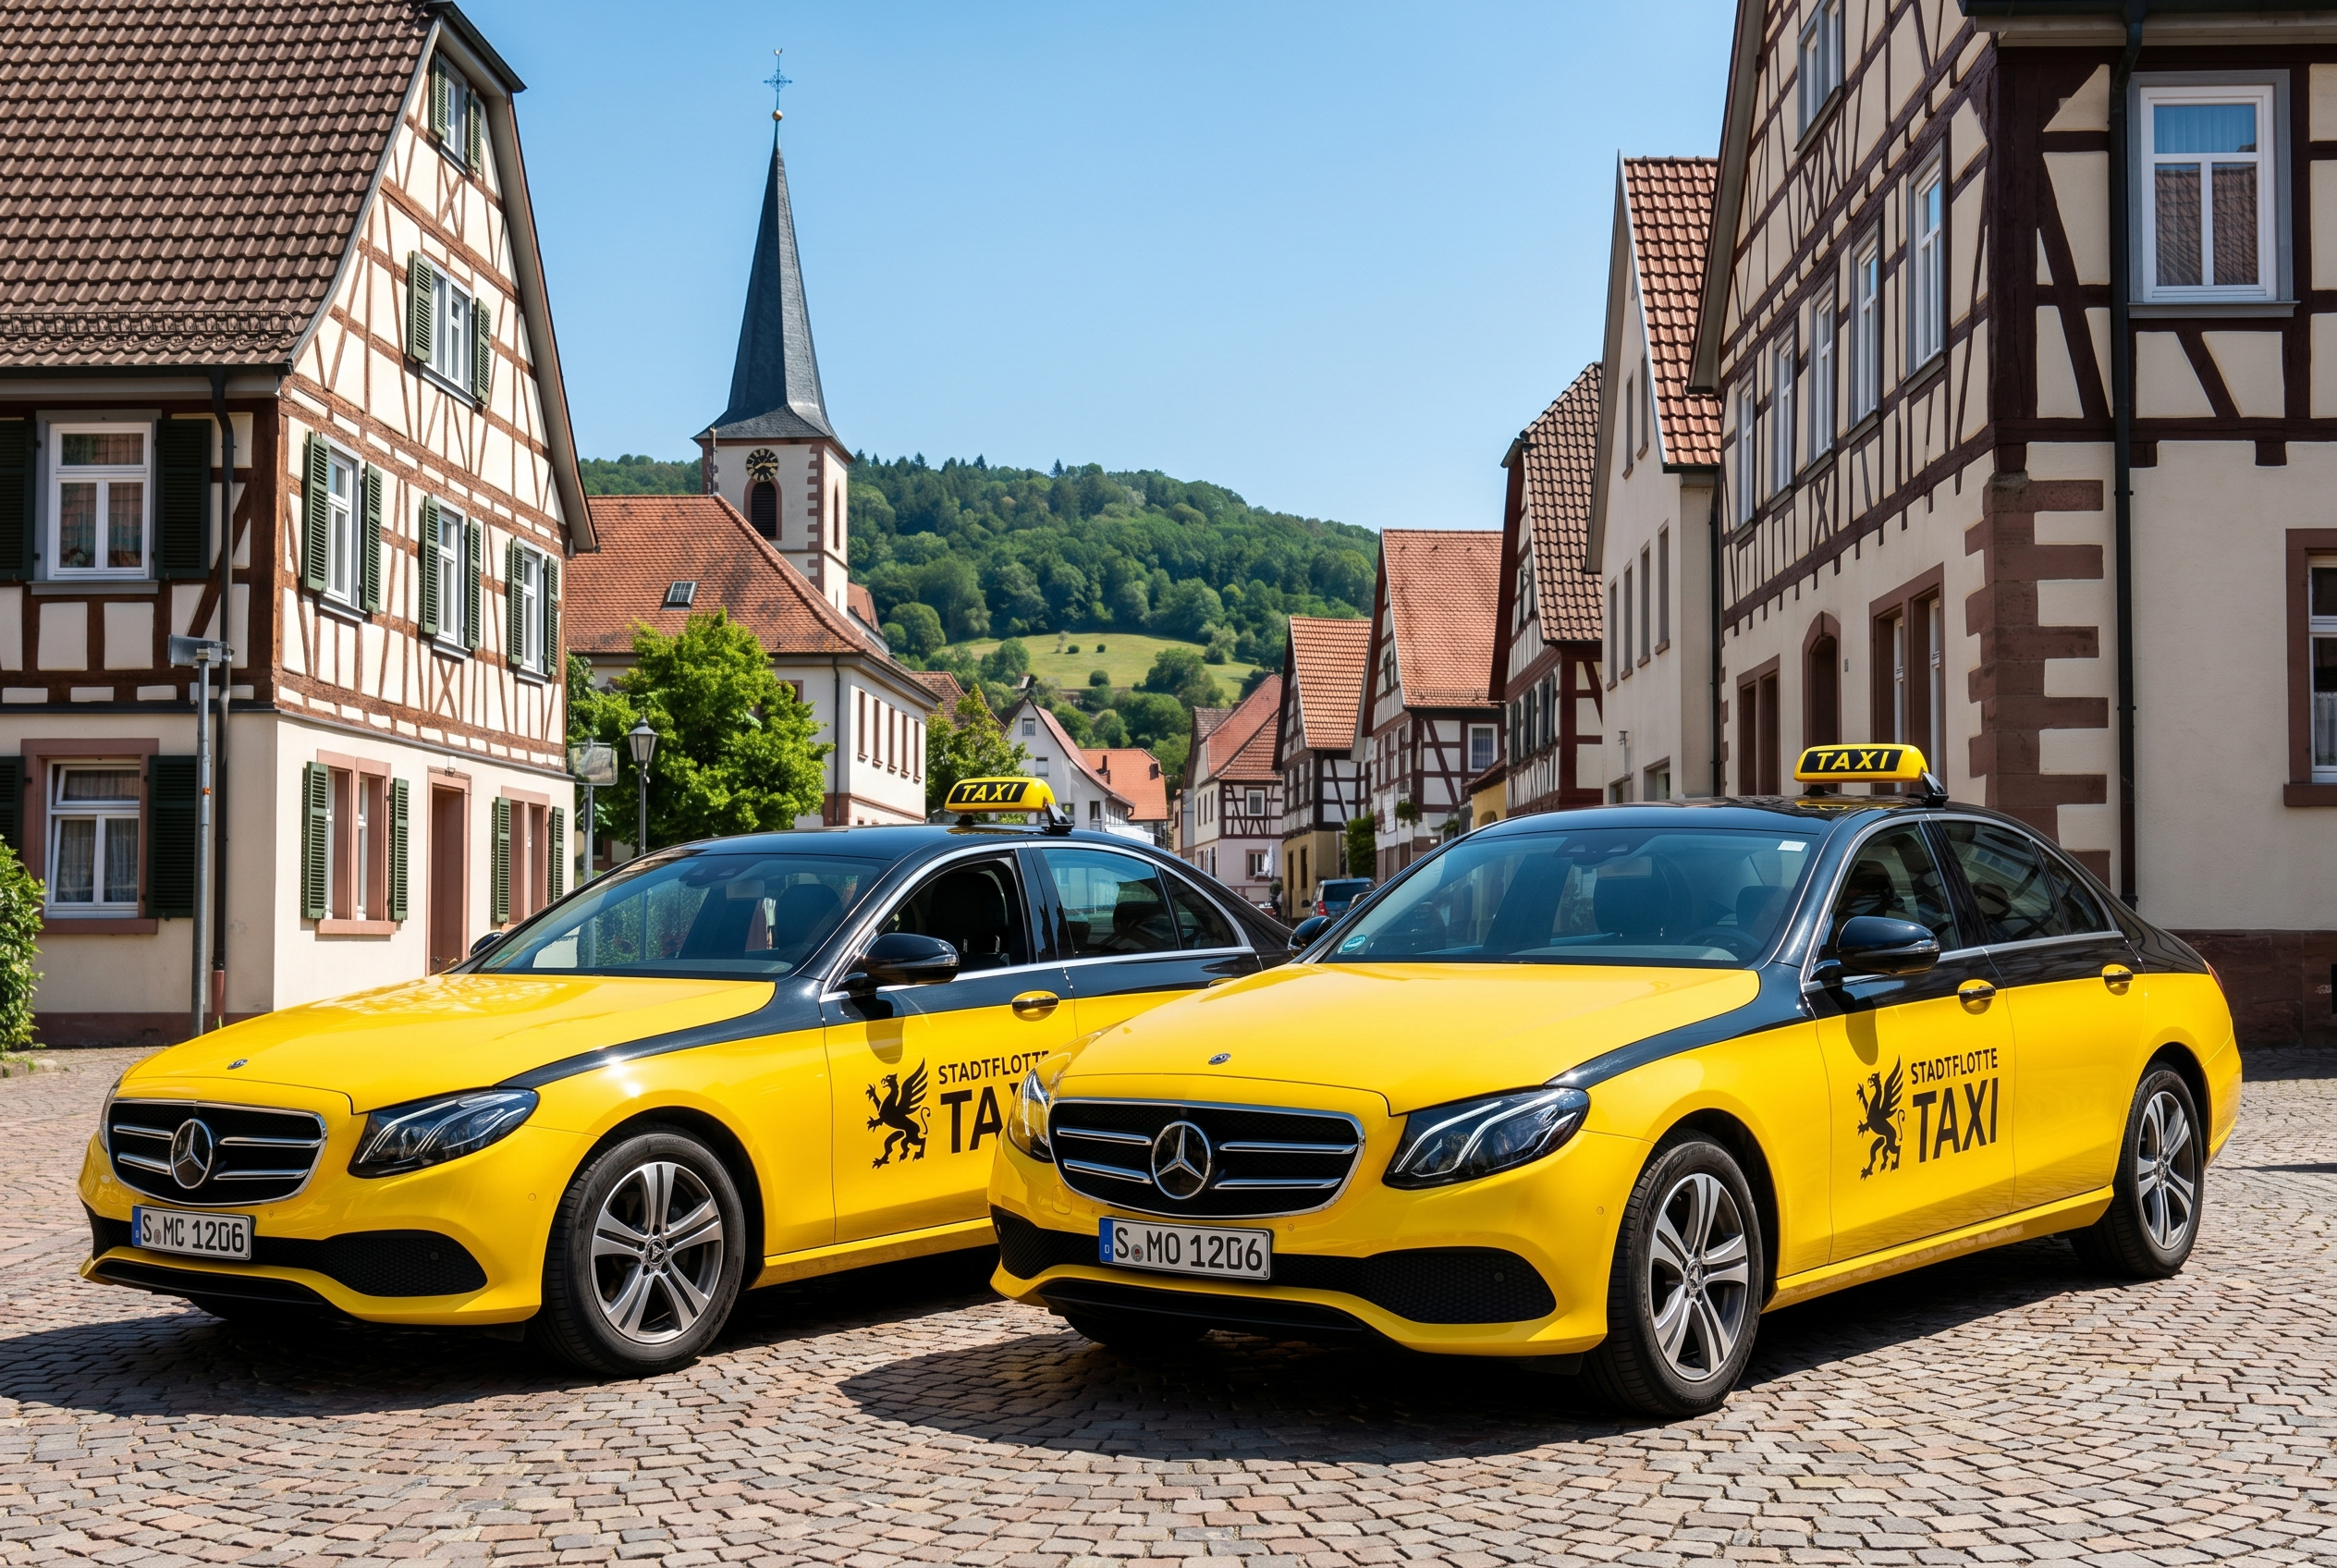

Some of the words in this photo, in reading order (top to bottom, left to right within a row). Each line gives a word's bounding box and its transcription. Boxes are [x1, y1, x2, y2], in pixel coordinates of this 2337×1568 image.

[1817, 751, 1890, 771] TAXI
[960, 783, 1019, 802] TAXI
[938, 1050, 1049, 1085] STADTFLOTT
[1910, 1047, 1999, 1085] STADTFLOTTE
[940, 1082, 1020, 1155] TA
[1912, 1077, 1999, 1164] TAXI
[142, 1214, 152, 1243] S
[163, 1216, 185, 1247] MC
[191, 1219, 245, 1253] 1206
[1115, 1227, 1129, 1259] S
[1146, 1230, 1181, 1265] MO
[1190, 1234, 1263, 1271] 1206
